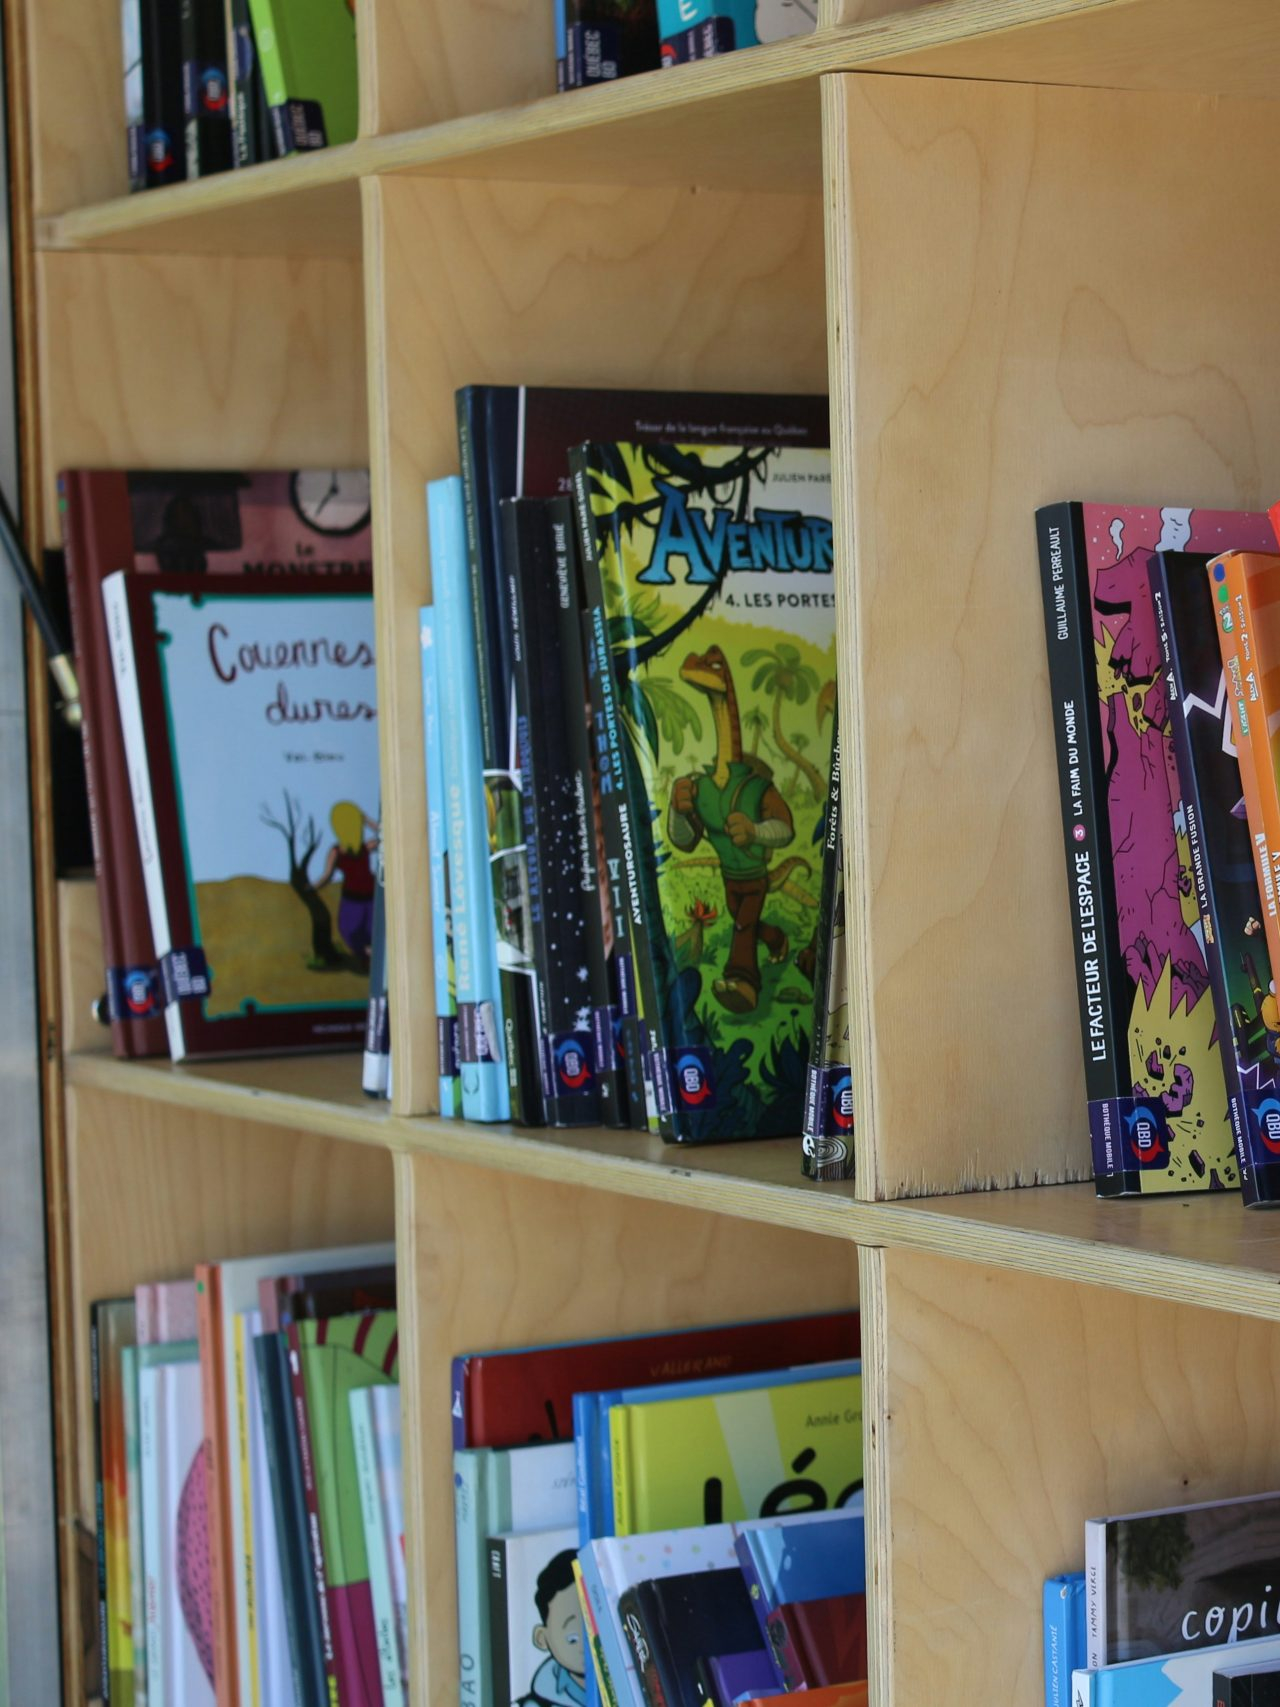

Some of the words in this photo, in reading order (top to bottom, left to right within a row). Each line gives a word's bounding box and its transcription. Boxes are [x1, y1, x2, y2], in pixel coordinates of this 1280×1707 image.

[1049, 527, 1064, 582] PERREAULT
[725, 596, 740, 606] 4.
[745, 594, 771, 607] LES
[1057, 584, 1069, 640] GUILLAUME
[592, 605, 608, 671] JURASSIA
[601, 674, 610, 693] DE
[266, 680, 377, 724] dures
[604, 695, 618, 748] PORTES
[1063, 701, 1078, 738] MONDE
[611, 750, 623, 775] LES
[1067, 740, 1079, 758] DU
[831, 787, 839, 801] &
[1070, 762, 1081, 794] FAIM
[1073, 797, 1083, 816] LA
[826, 806, 837, 849] Forêts
[1187, 804, 1200, 844] FUSION
[618, 802, 643, 925] AVENTUROSAURE
[1192, 847, 1208, 892] GRANDE
[1075, 851, 1095, 928] L'ESPACE
[1082, 929, 1097, 954] DE
[1084, 958, 1103, 1035] FACTEUR
[1092, 1039, 1106, 1062] LE
[1137, 1122, 1151, 1148] QBD
[1237, 1135, 1246, 1164] MOBILE
[1105, 1141, 1114, 1169] MOBILE
[805, 1413, 840, 1429] Annie
[1050, 1625, 1058, 1674] CASTANIÉ
